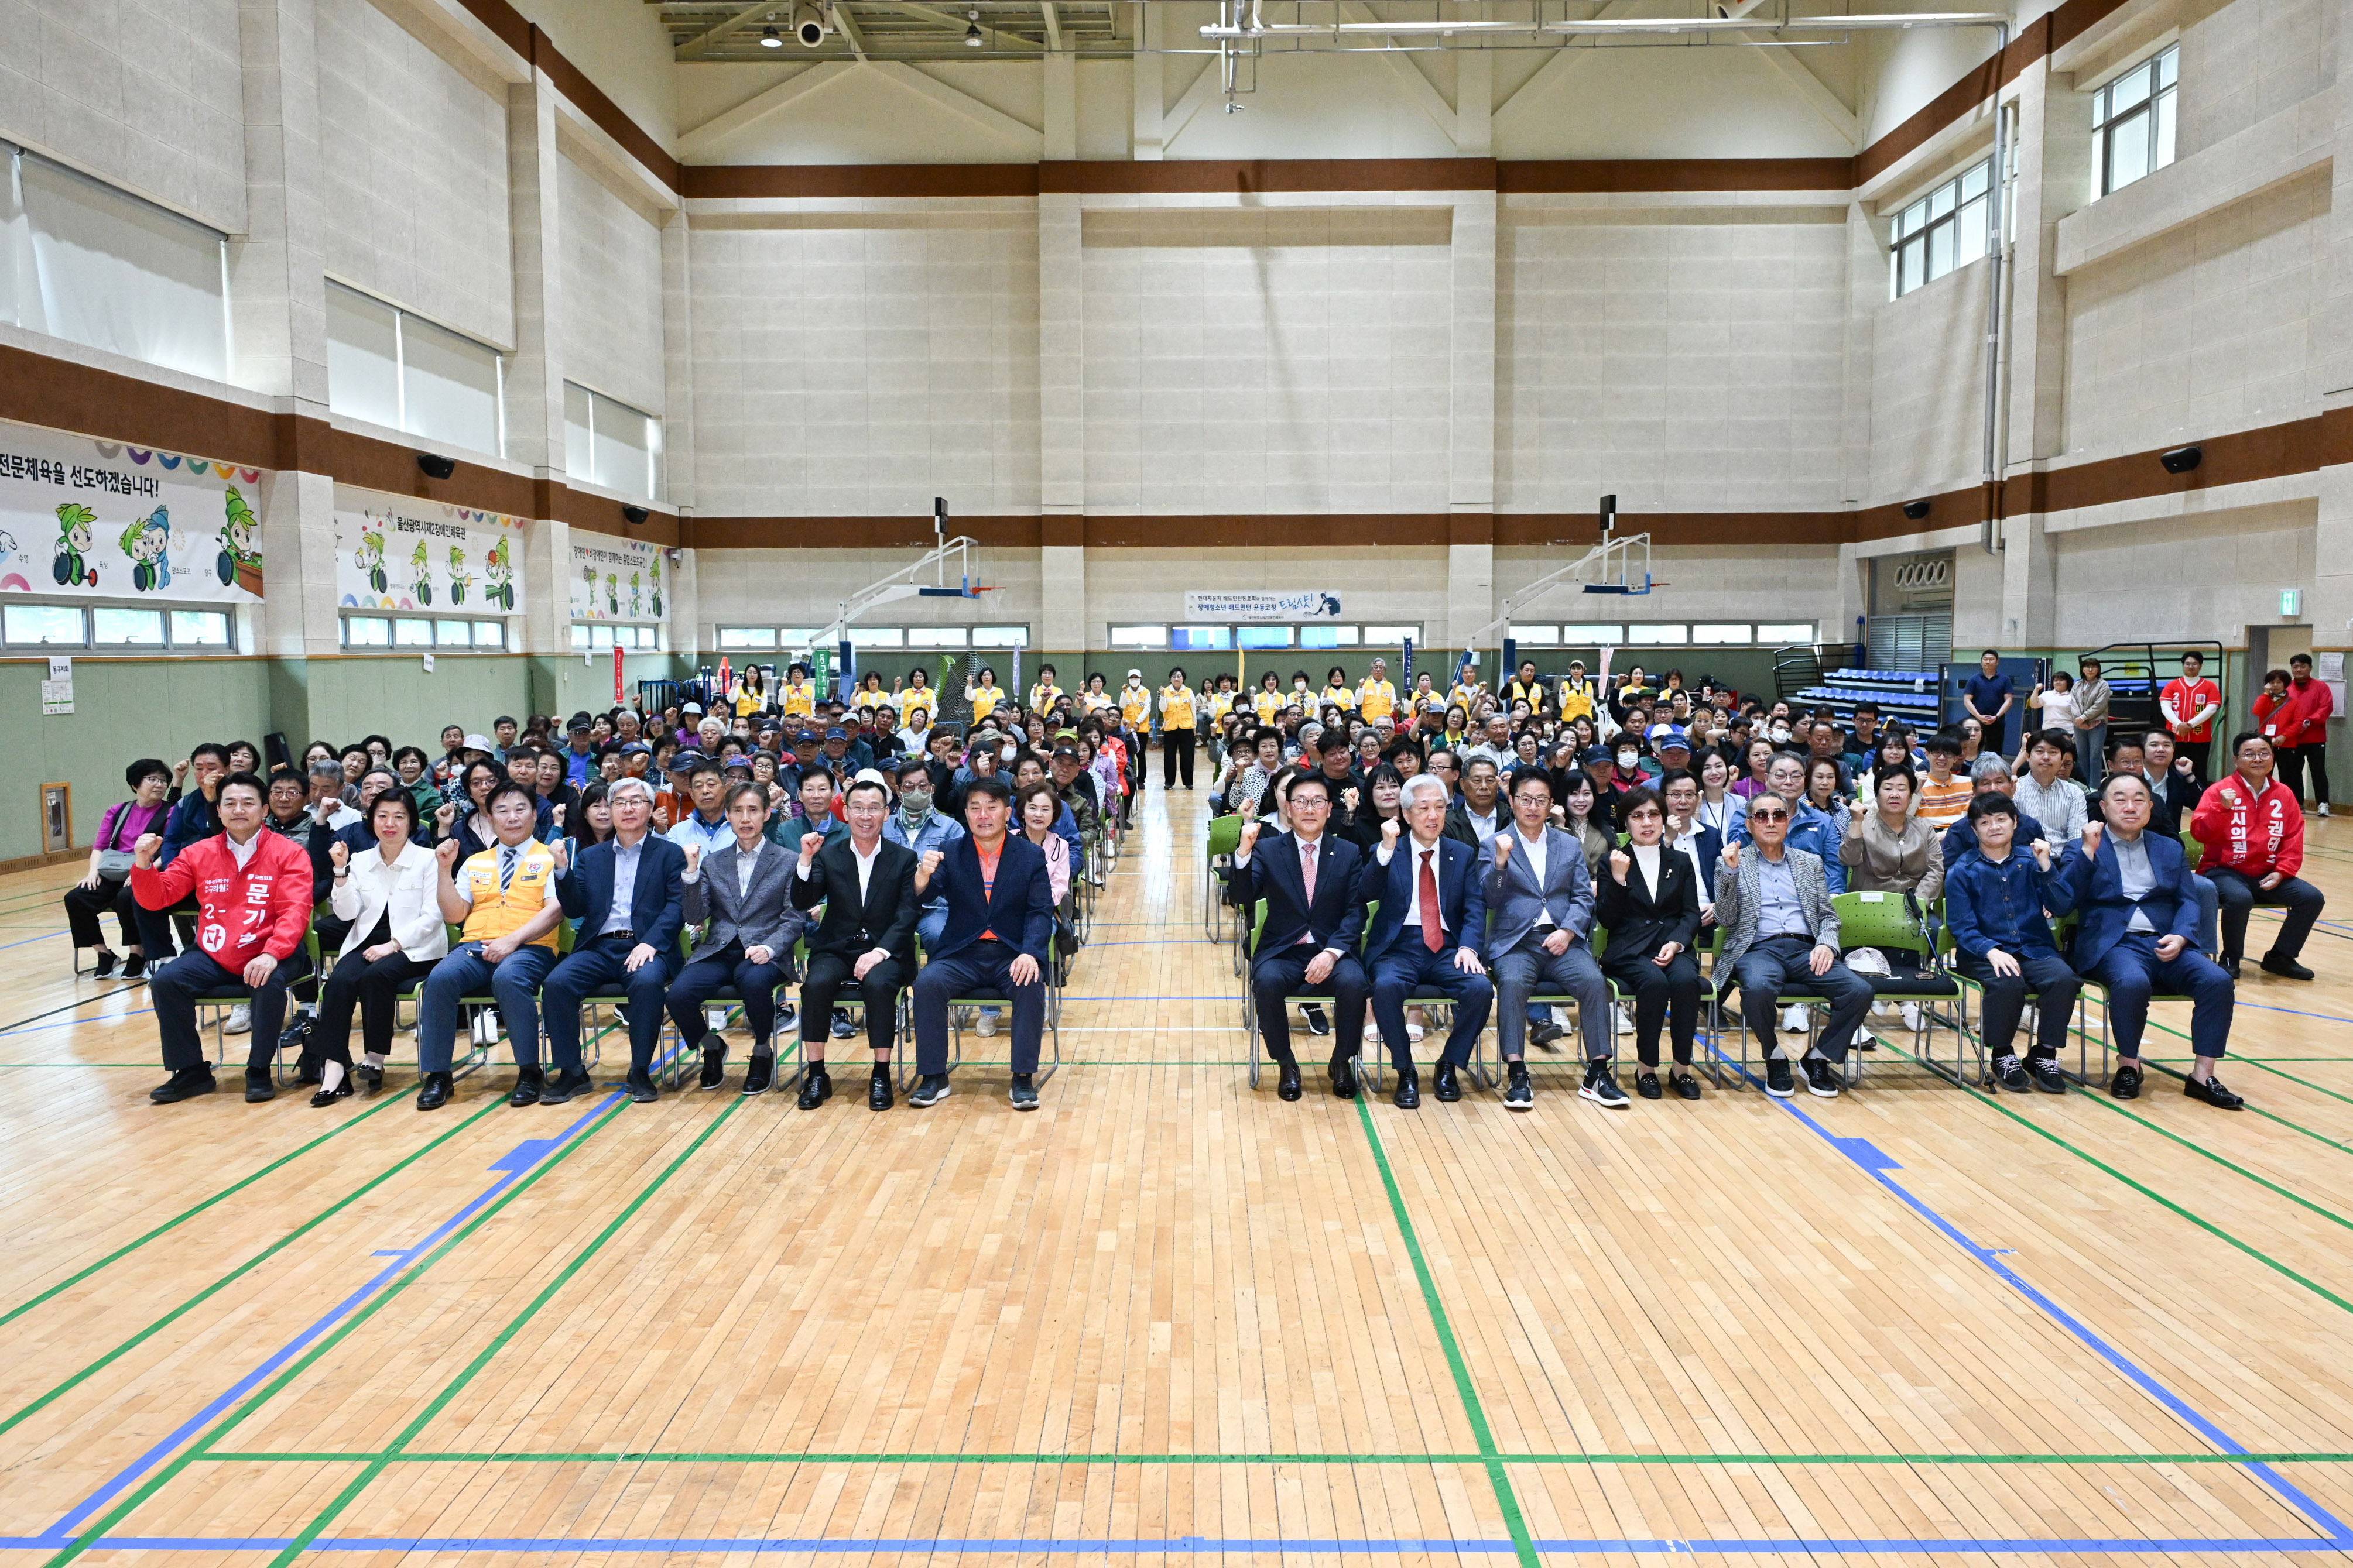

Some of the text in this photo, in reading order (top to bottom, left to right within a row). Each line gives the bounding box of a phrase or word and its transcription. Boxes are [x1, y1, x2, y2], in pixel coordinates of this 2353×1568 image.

[0, 454, 159, 498] 전문체육을 선도하겠습니다!
[397, 517, 466, 540] 울산광역시제2장애인체육관
[19, 554, 29, 563] 수영
[99, 561, 108, 569] 육상
[53, 665, 69, 674] 동구지회
[2173, 692, 2179, 701] 2
[2270, 799, 2283, 818] 2
[2231, 812, 2247, 853] 시의원
[208, 884, 226, 893] 구의원
